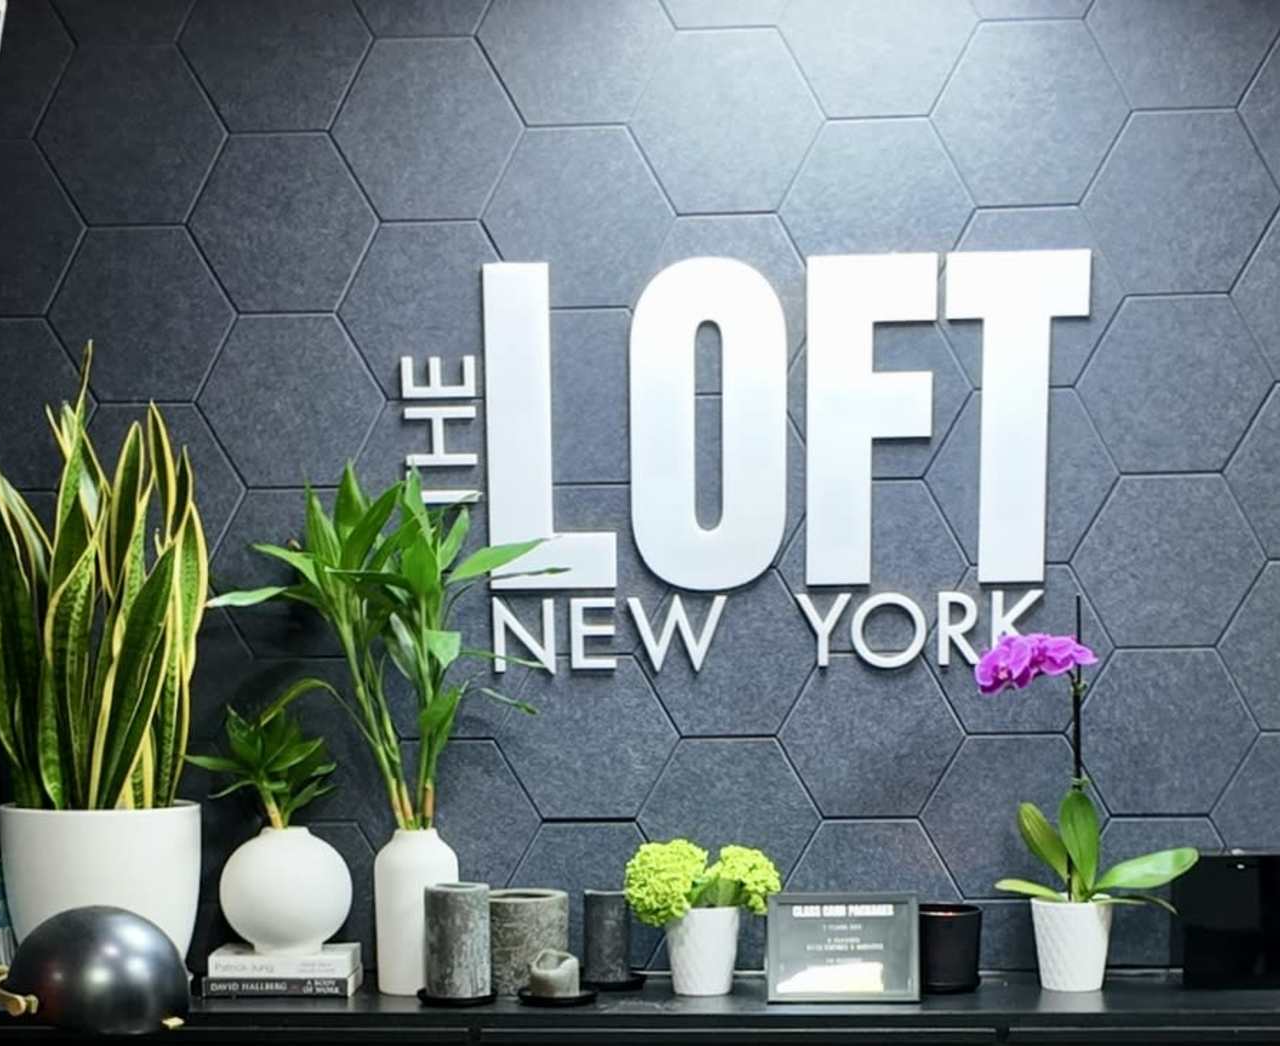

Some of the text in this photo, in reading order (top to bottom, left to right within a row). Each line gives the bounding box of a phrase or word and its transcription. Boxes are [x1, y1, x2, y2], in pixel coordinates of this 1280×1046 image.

[481, 248, 1091, 591] LOFT
[490, 589, 1045, 675] NEW YORK
[210, 982, 239, 992] DAVID
